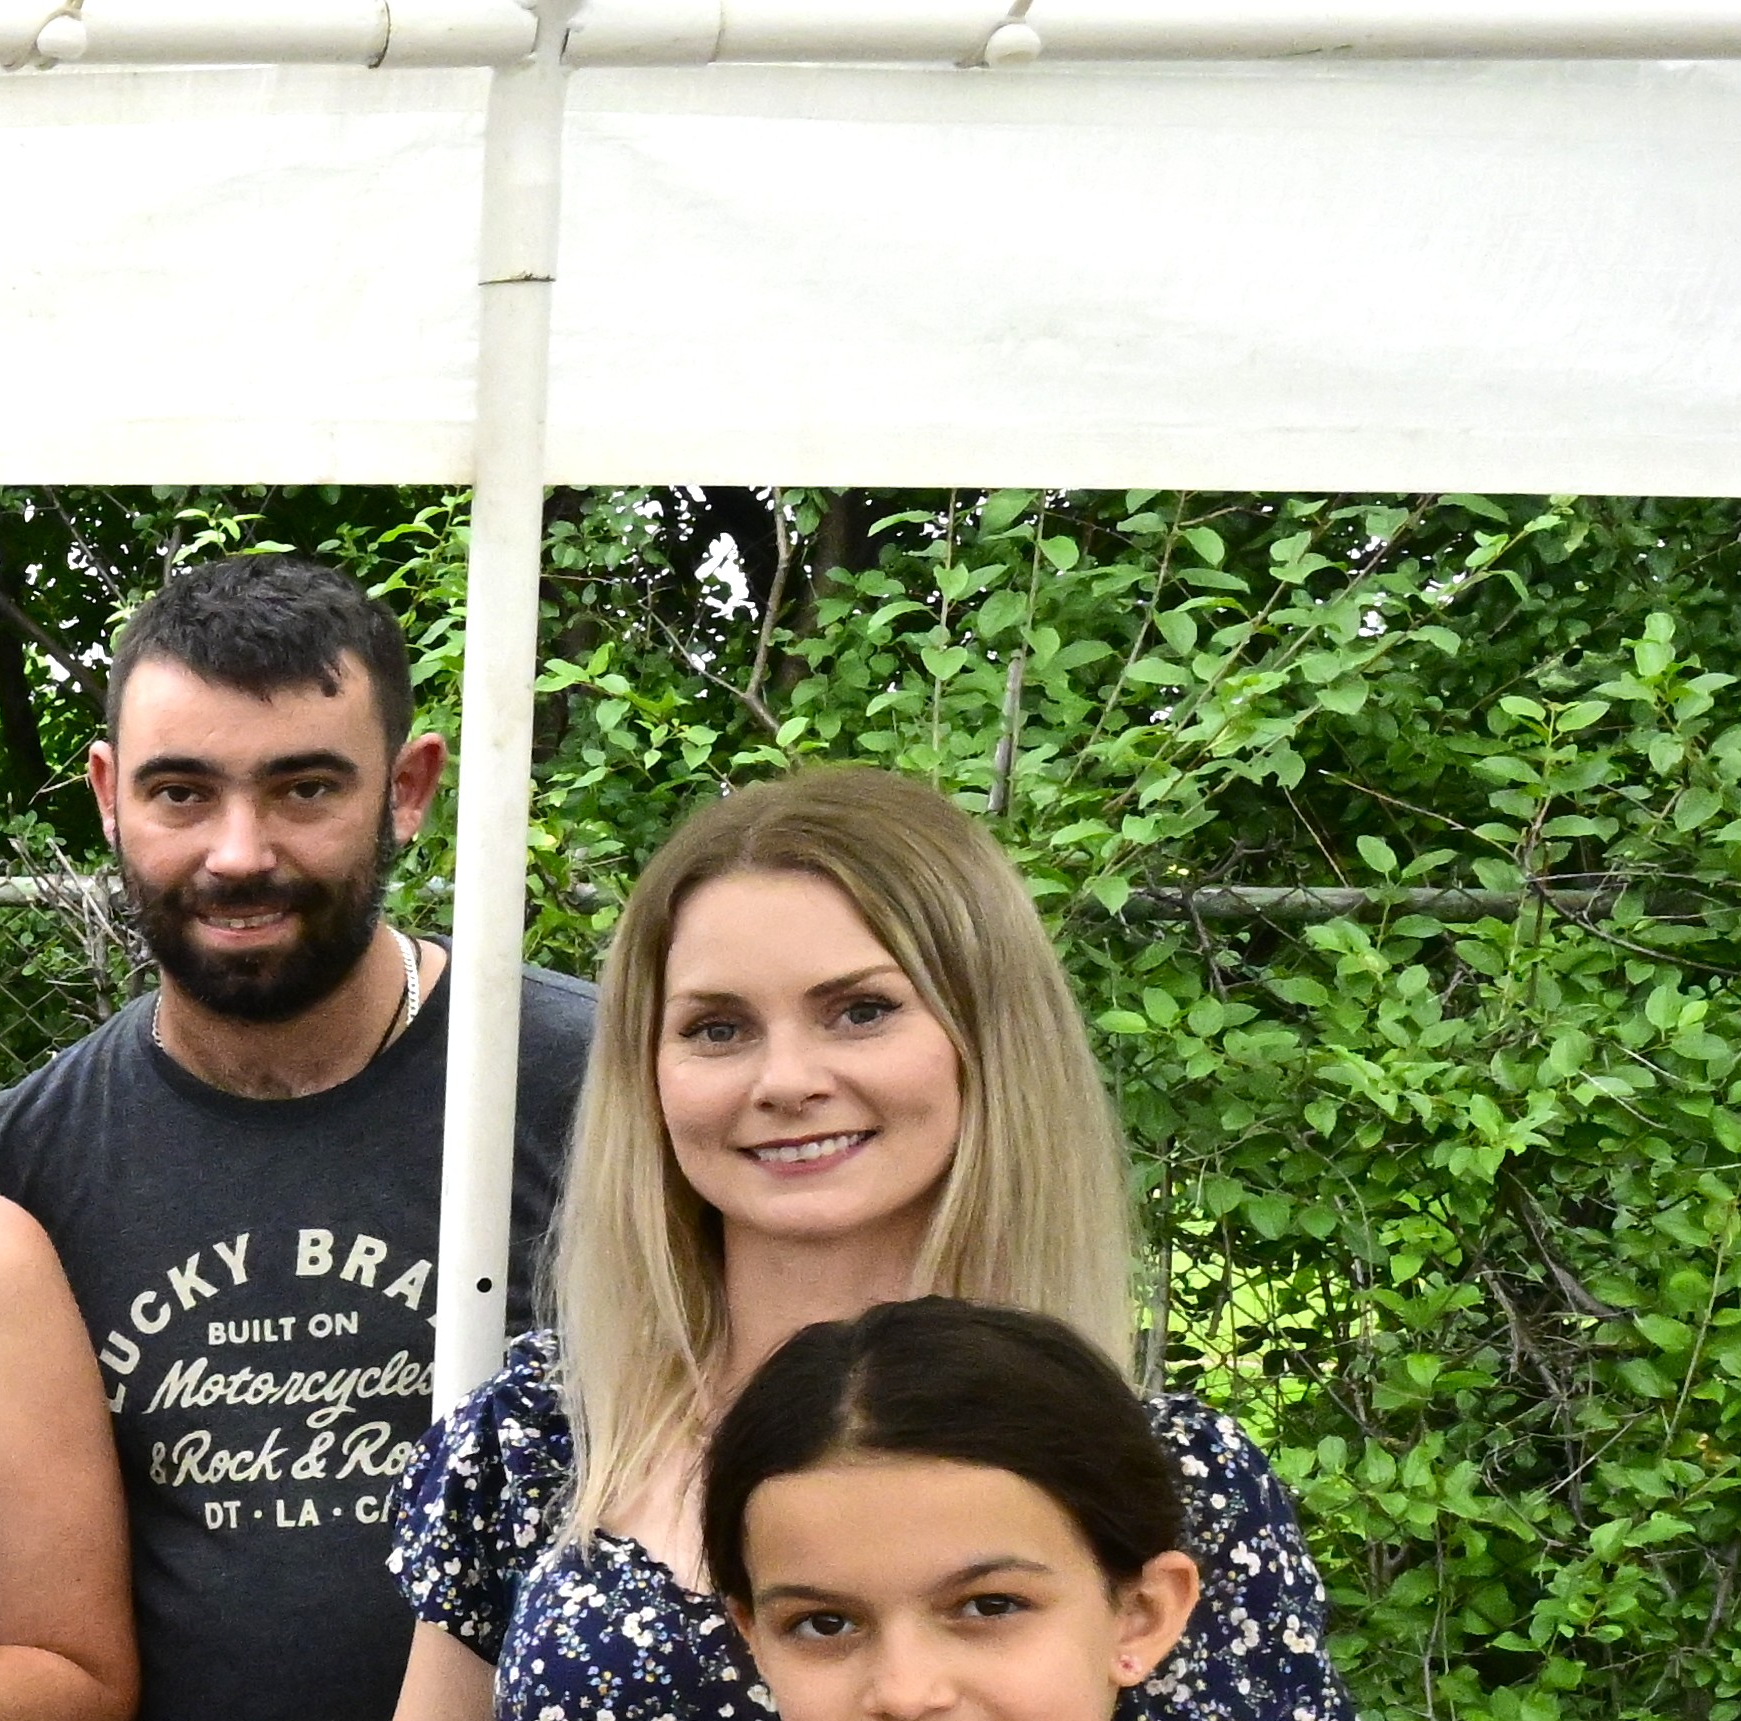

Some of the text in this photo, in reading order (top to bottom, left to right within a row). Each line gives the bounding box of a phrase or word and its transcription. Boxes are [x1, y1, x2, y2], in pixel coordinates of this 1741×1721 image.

[295, 1228, 439, 1330] BRA
[208, 1311, 358, 1346] BUILT ON
[142, 1350, 436, 1428] Motorcycles
[172, 1427, 289, 1487] Rock
[291, 1431, 335, 1480] &
[333, 1421, 412, 1480] Ro
[205, 1501, 241, 1529] DT
[277, 1497, 320, 1528] LA
